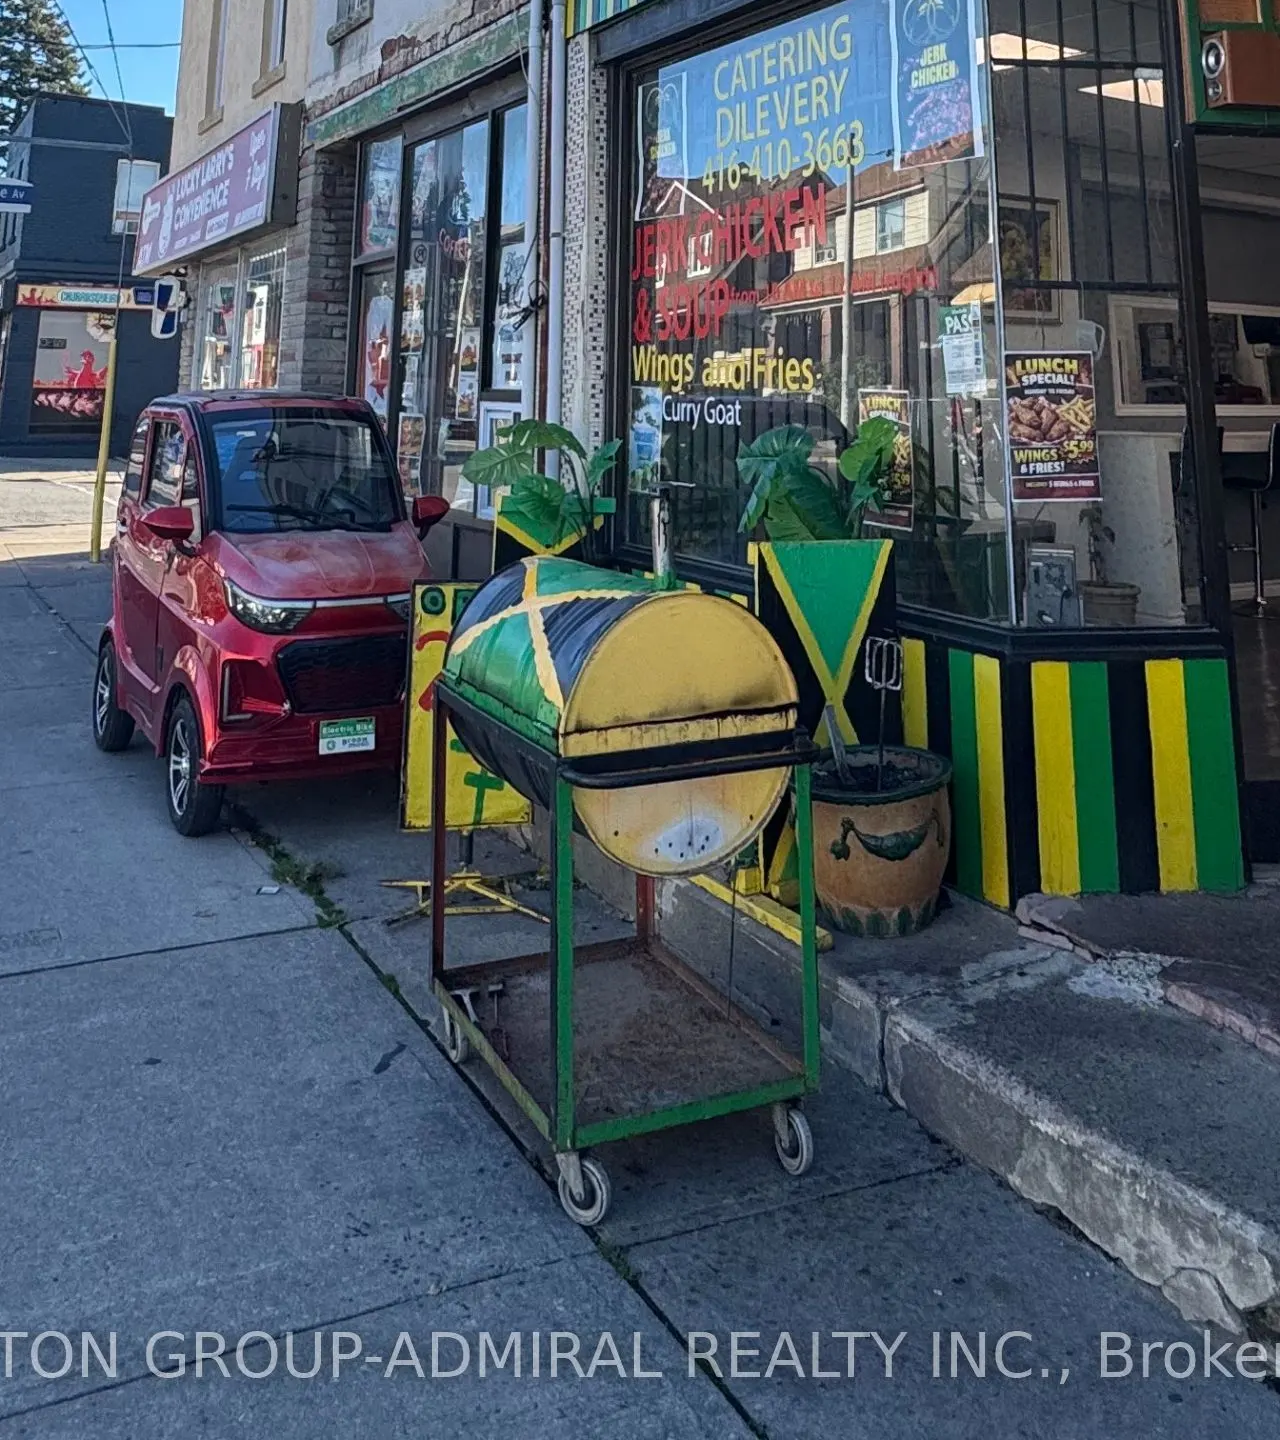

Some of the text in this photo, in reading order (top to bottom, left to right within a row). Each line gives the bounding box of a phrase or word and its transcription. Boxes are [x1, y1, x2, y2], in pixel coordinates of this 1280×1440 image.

[714, 14, 851, 101] CATERING
[921, 42, 948, 67] JERK
[911, 60, 956, 90] CHICKEN
[716, 68, 849, 148] DILEVERY
[702, 119, 865, 195] 416-410-3663
[11, 189, 25, 199] Av
[175, 165, 201, 201] LUCKY
[174, 178, 230, 231] CONVENIENCE
[632, 182, 827, 281] JERK CHICKEN
[634, 288, 651, 342] &
[655, 279, 730, 341] SOUP
[945, 314, 973, 335] PAS
[632, 345, 814, 393] Wings and Fries
[1015, 358, 1079, 375] LUNCH
[1022, 373, 1075, 386] SPECIAL!
[662, 395, 742, 430] Curry Goat
[866, 396, 901, 412] LUNCH
[1014, 449, 1059, 463] WINGS
[1063, 440, 1094, 459] $5.99
[1029, 461, 1065, 474] FRIES!
